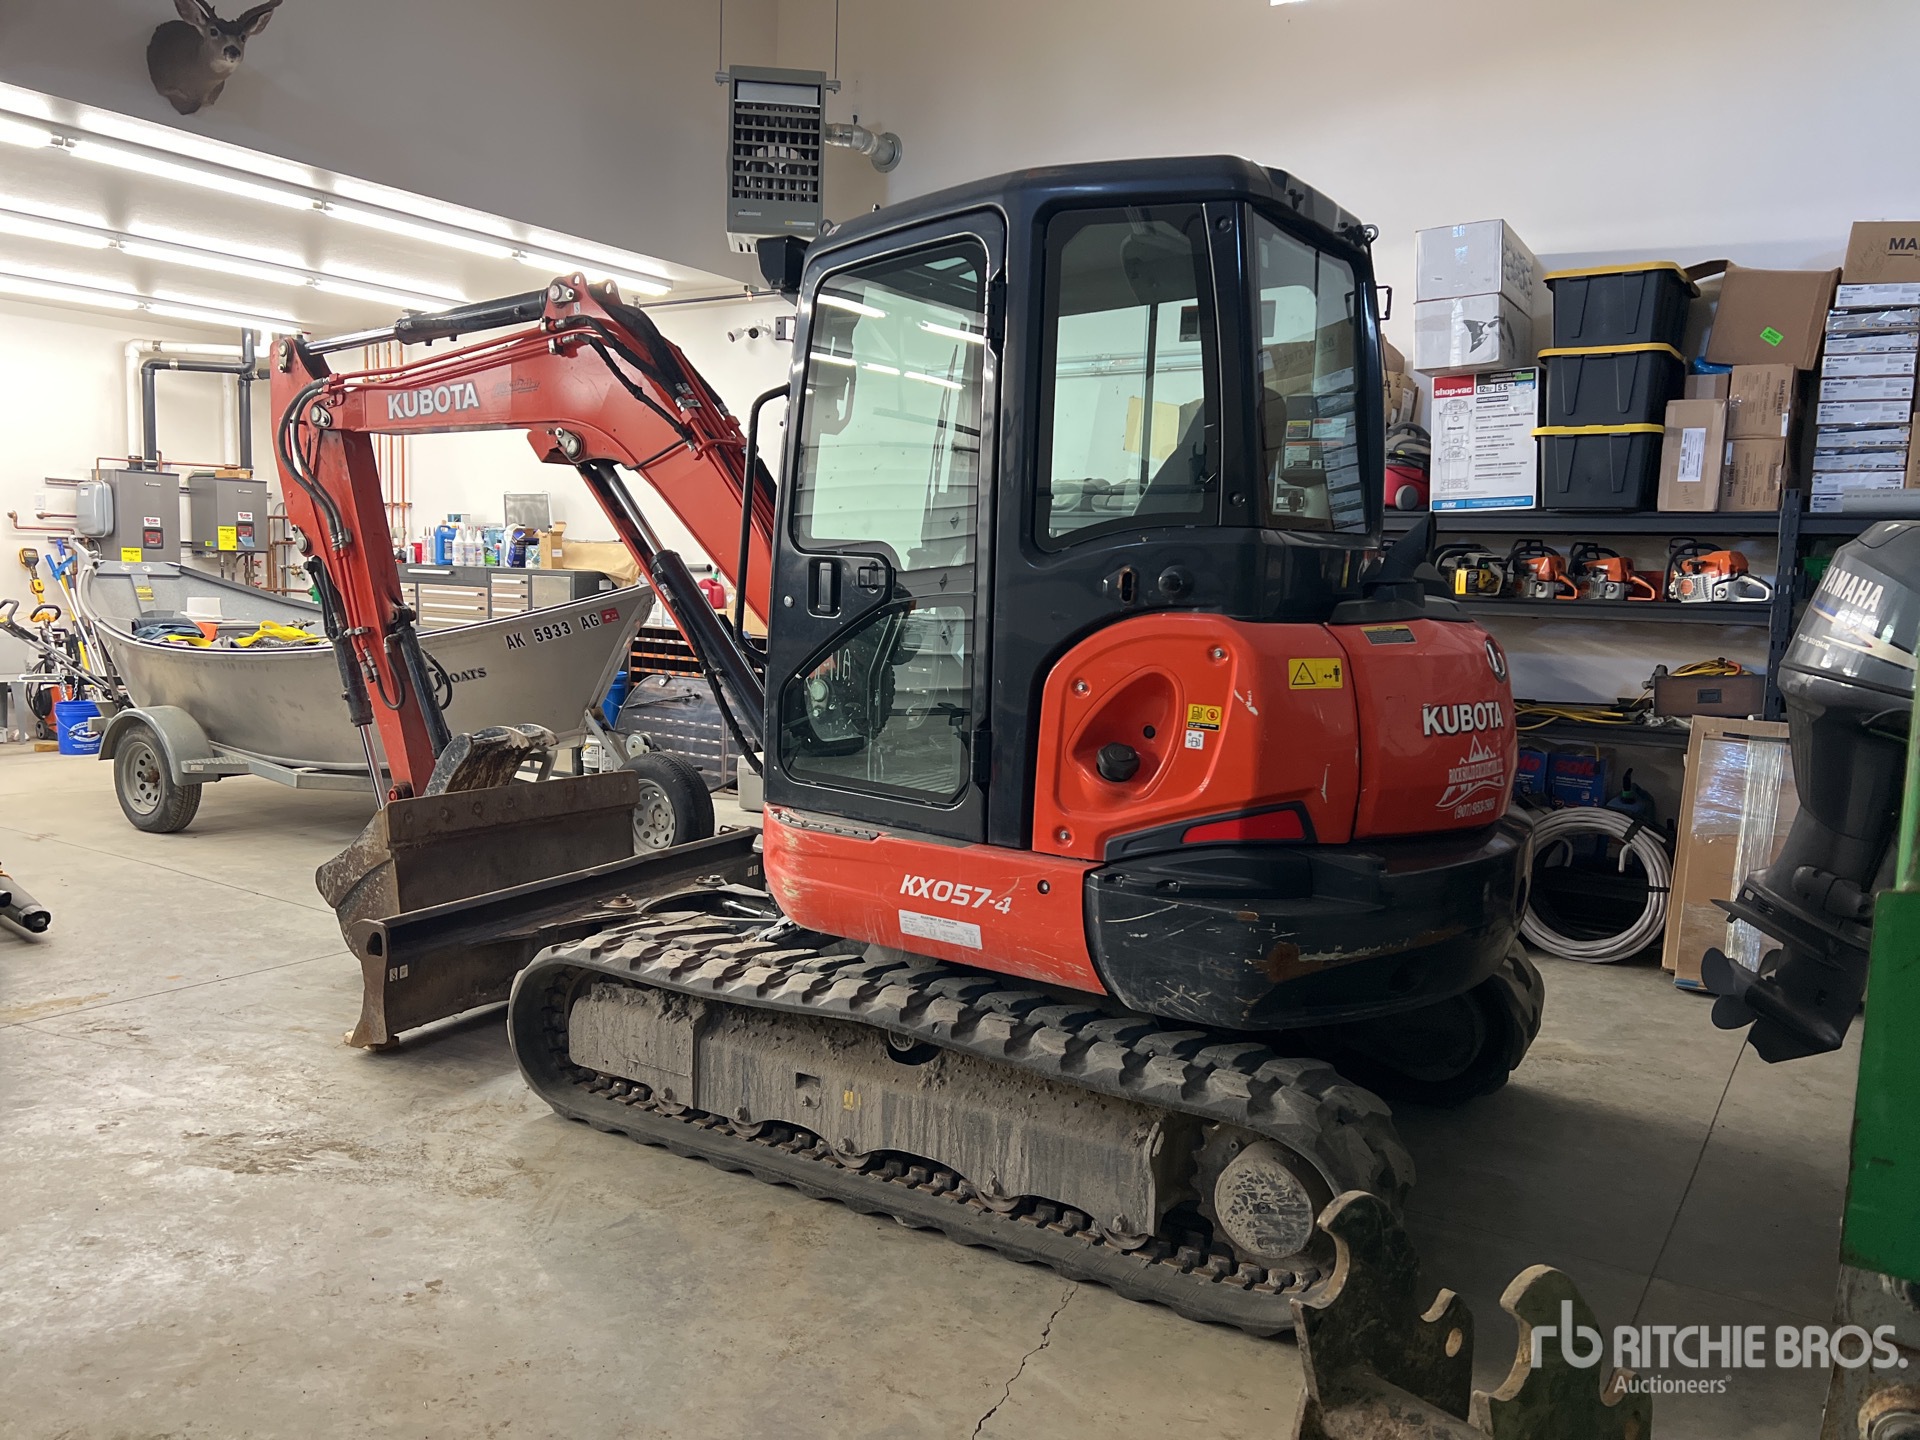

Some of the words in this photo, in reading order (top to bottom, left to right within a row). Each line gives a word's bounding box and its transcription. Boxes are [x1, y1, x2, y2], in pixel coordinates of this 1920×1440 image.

[1889, 237, 1920, 250] MA
[387, 382, 479, 419] KUBOTA
[1822, 565, 1884, 613] YAMAHA
[506, 633, 525, 649] AK
[534, 622, 571, 643] 5933
[581, 613, 599, 630] AG
[441, 668, 487, 684] OATS
[1422, 702, 1504, 735] KUBOTA
[900, 874, 1012, 915] KX057-4
